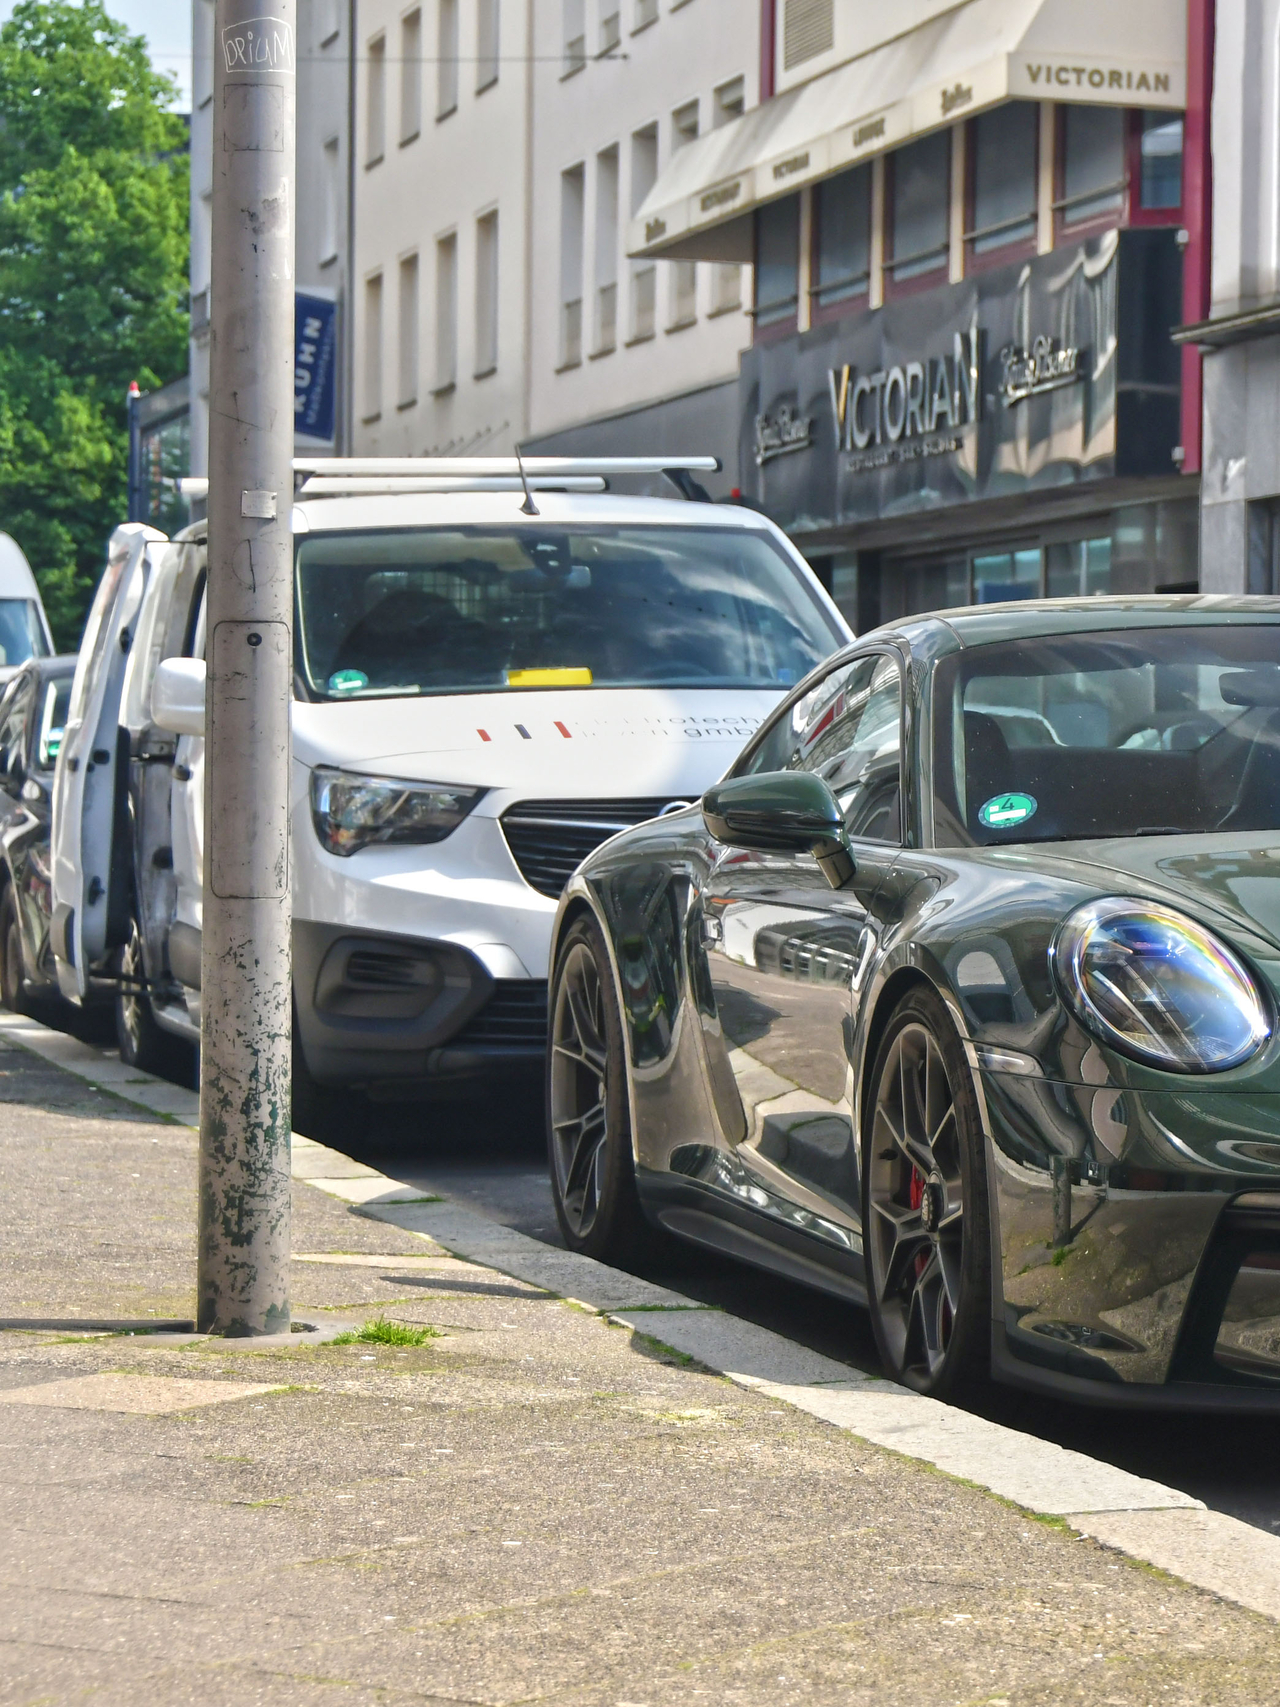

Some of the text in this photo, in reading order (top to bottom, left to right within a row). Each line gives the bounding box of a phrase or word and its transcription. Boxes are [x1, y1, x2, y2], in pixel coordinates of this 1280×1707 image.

[1025, 63, 1170, 93] VICTORIAN
[828, 326, 978, 450] VICTORIAN
[684, 727, 757, 738] gmb
[1001, 797, 1015, 810] 4
